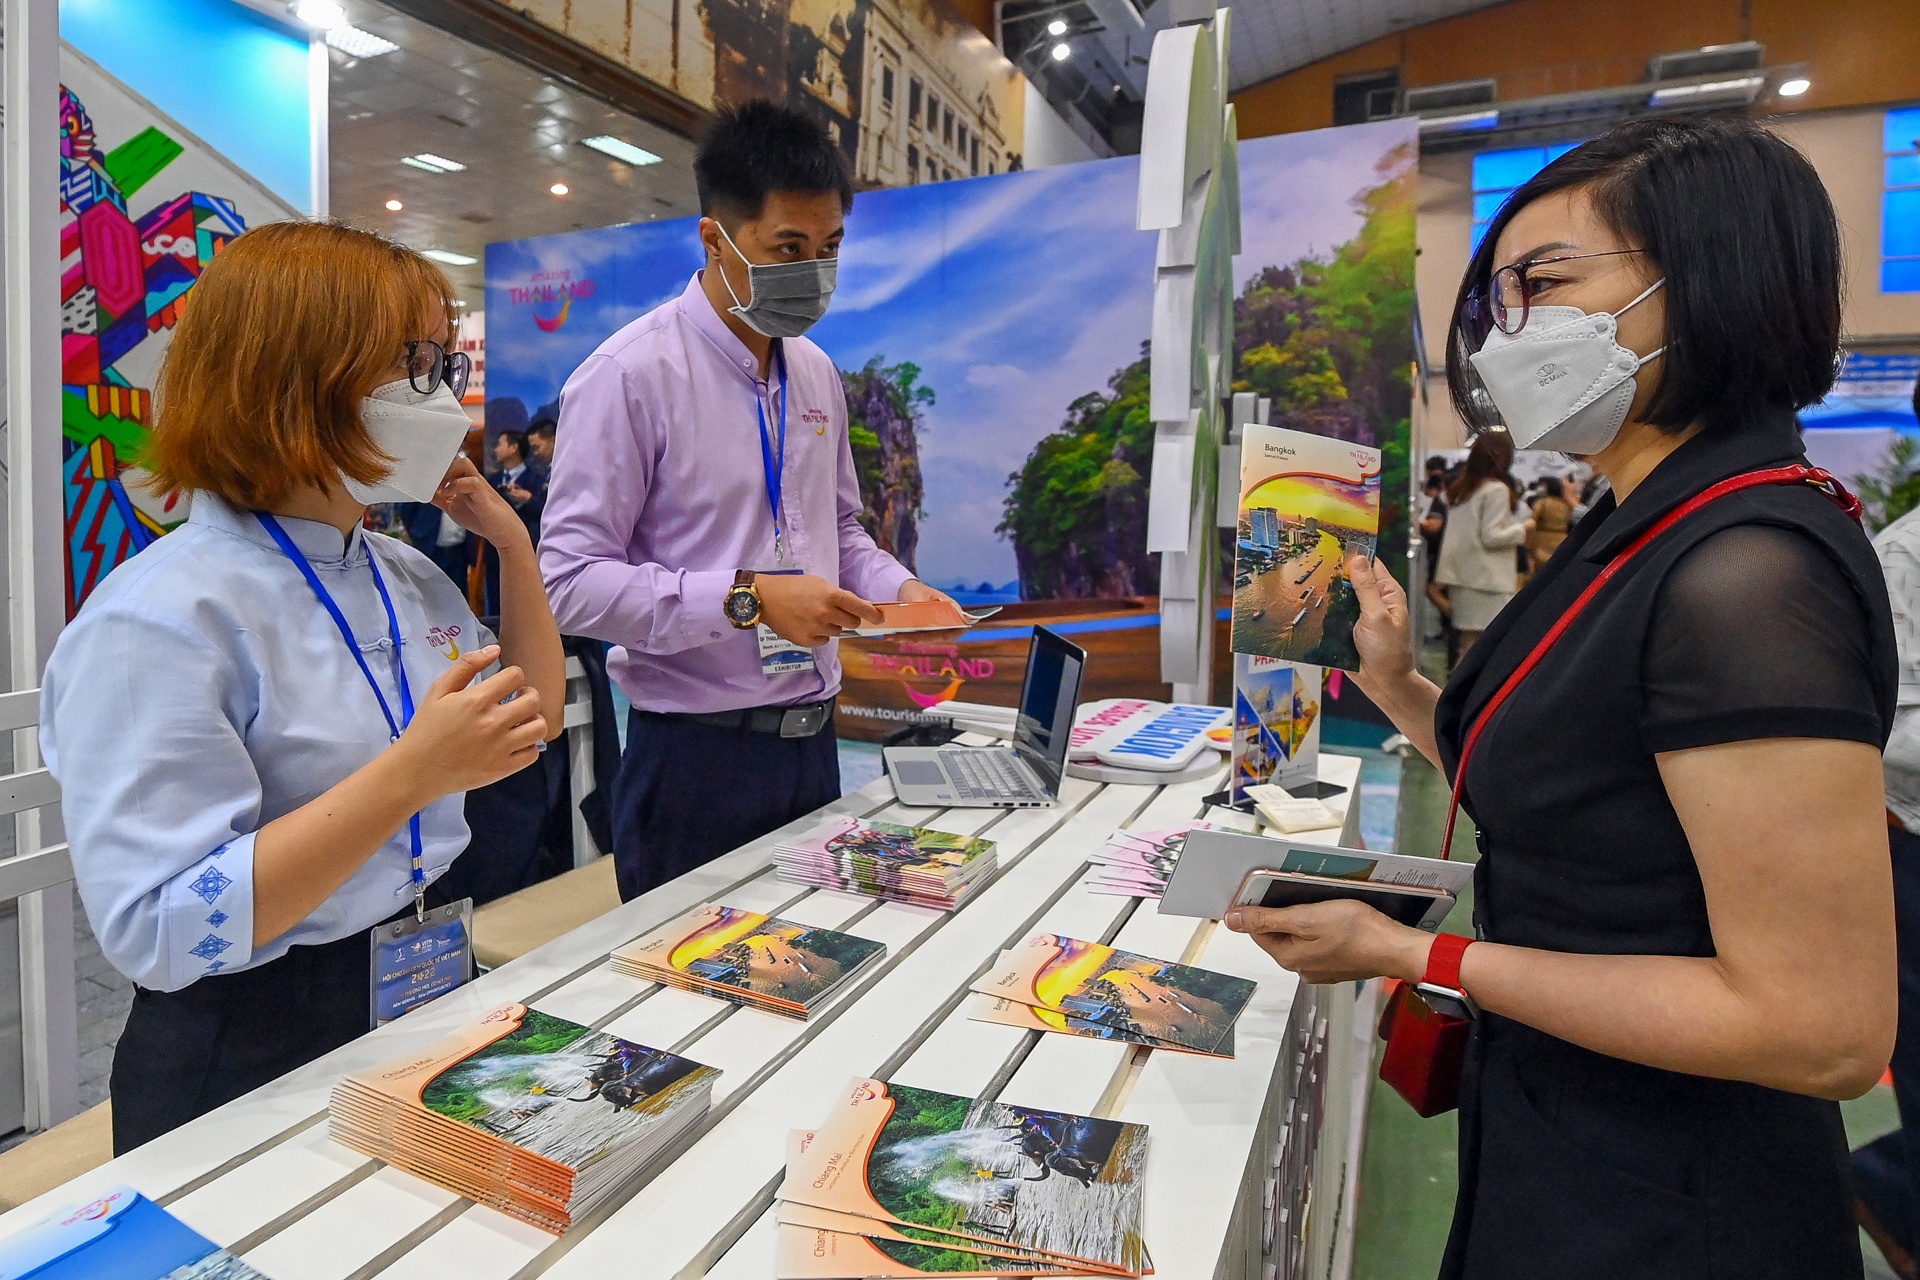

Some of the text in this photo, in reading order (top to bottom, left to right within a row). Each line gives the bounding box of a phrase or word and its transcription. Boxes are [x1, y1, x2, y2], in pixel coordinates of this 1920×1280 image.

[509, 280, 595, 304] THAILAND
[1265, 443, 1297, 455] Bangkok
[869, 653, 995, 679] THAILAND
[1109, 706, 1226, 759] BANGKOK
[382, 1064, 415, 1079] Chiang
[851, 1081, 871, 1107] THAILAND
[812, 1152, 843, 1189] Chiang Mai
[813, 1229, 829, 1257] Chiang
